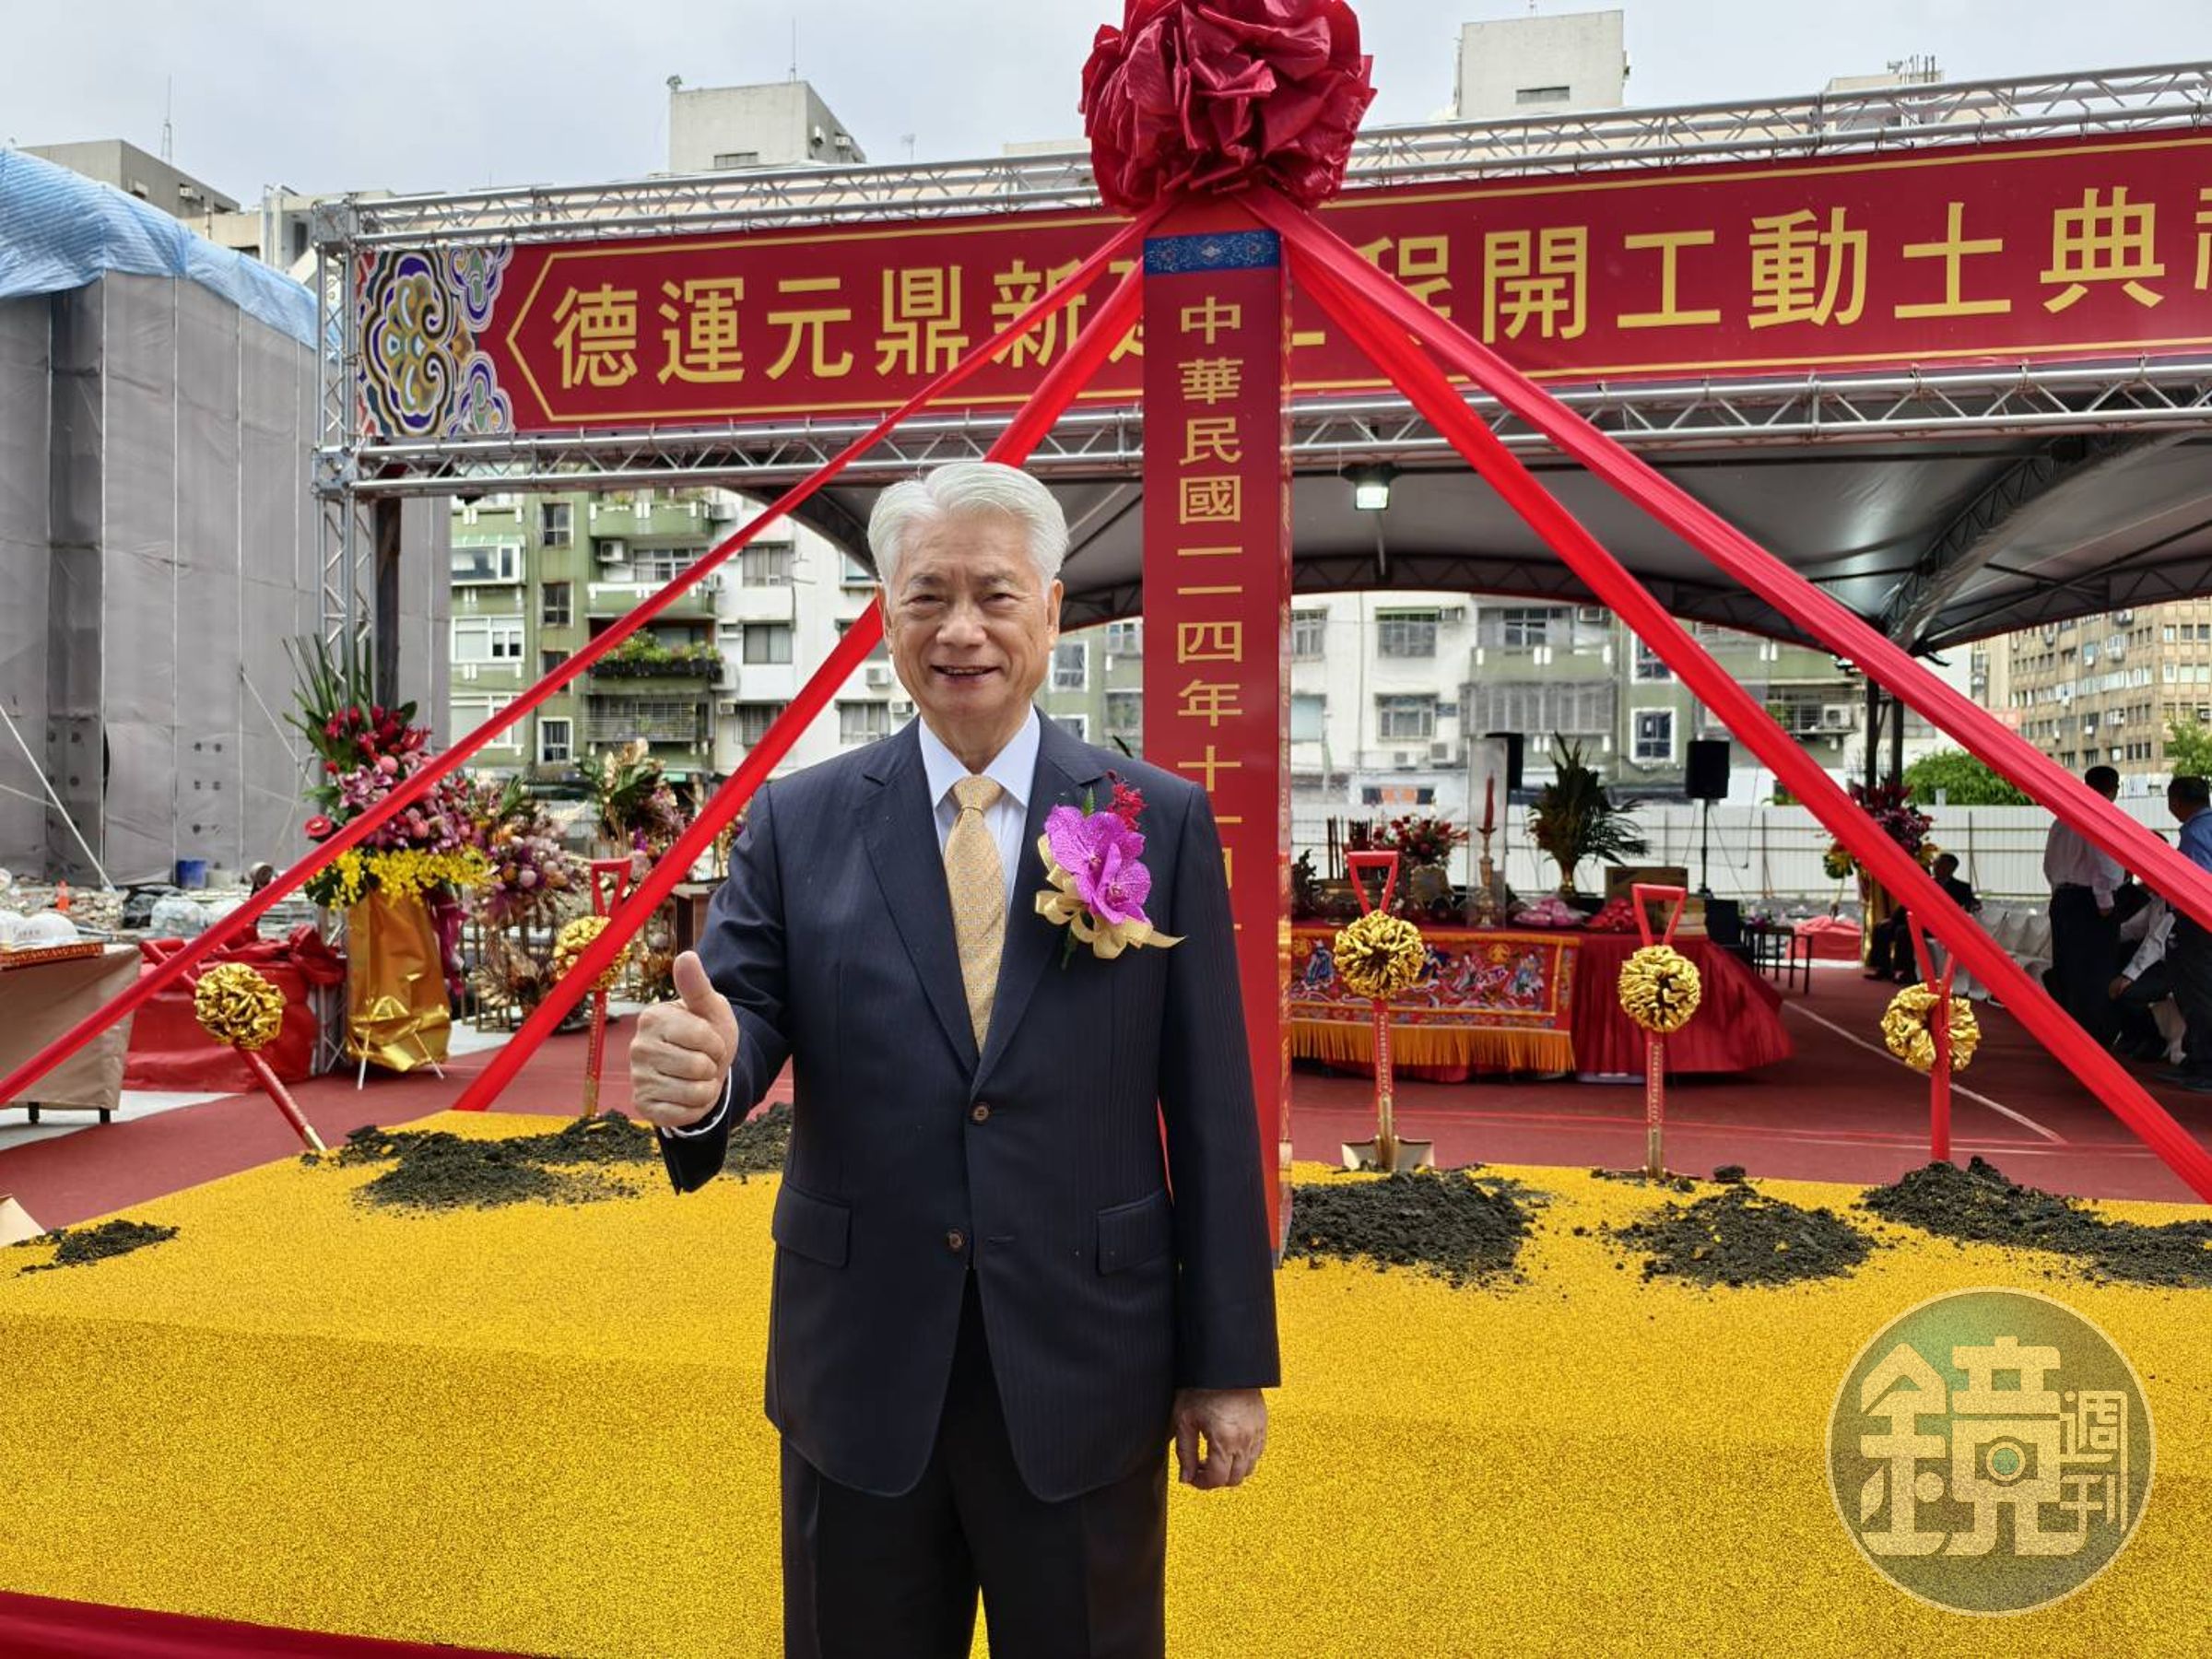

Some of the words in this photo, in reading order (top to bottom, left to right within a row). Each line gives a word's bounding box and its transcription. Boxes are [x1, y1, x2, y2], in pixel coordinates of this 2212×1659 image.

[552, 187, 2212, 389] 德運元鼎新開工動土典
[1176, 295, 1243, 930] 中華民國一一四年十
